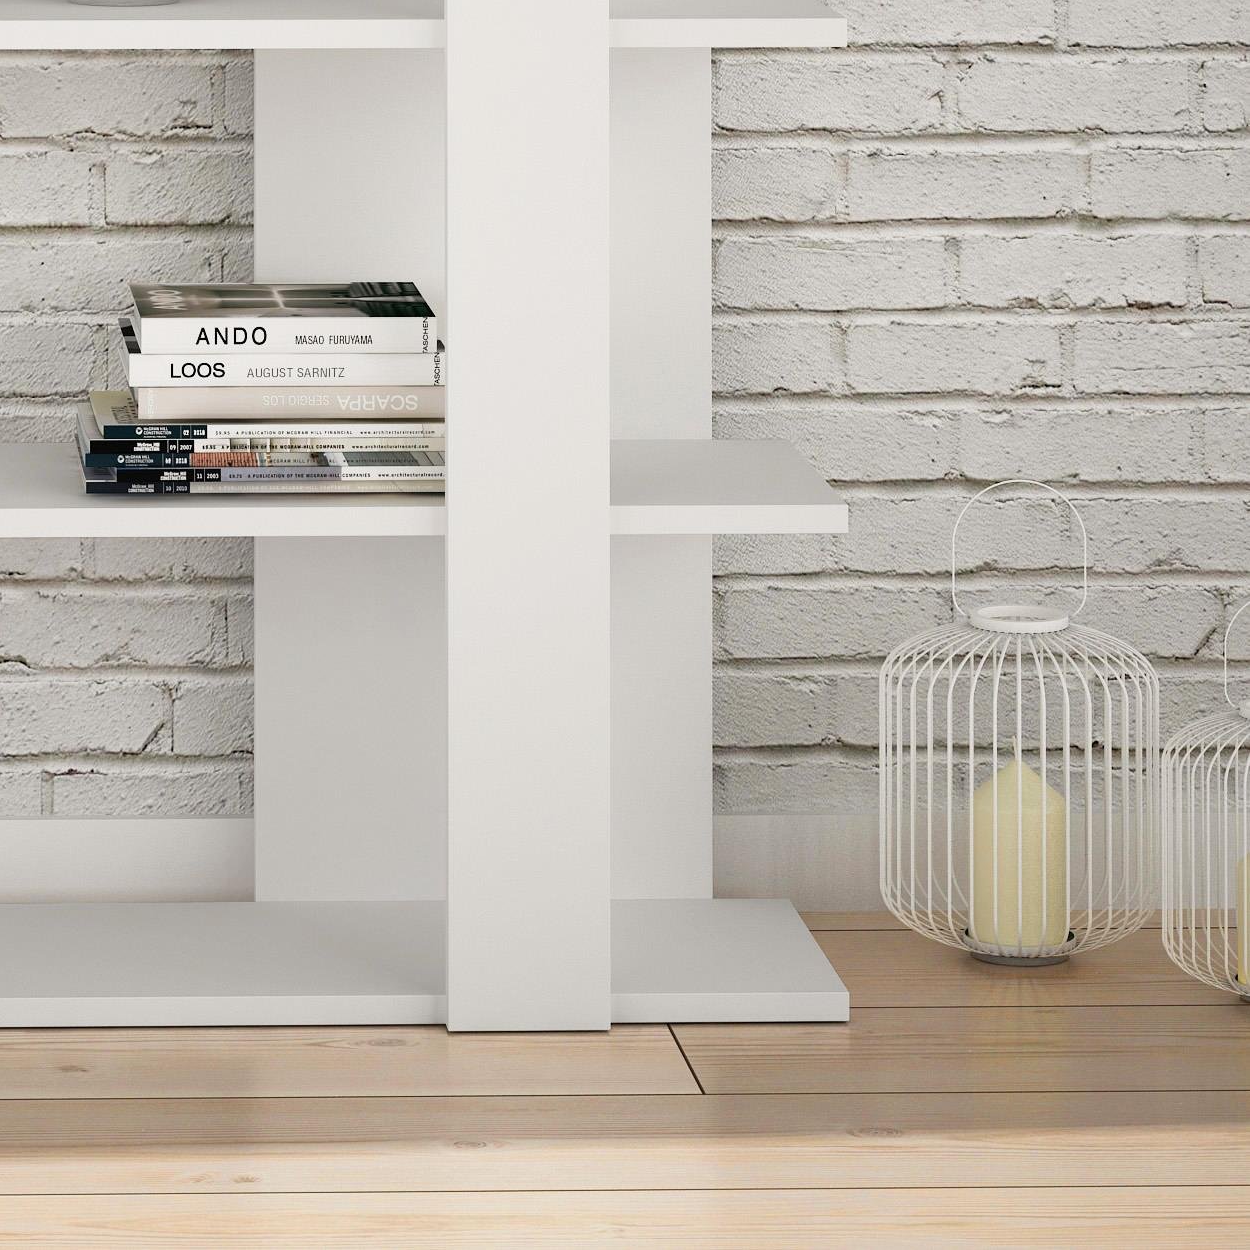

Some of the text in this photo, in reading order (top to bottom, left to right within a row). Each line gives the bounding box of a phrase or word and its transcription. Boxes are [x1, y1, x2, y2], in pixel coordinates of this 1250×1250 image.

[195, 326, 268, 346] ANDO
[295, 334, 373, 345] MASAO FURUYAMA
[170, 362, 226, 379] LOOS
[246, 366, 347, 378] AUGUST SARNITZ
[262, 395, 418, 411] SCARPA SERGIO LOS
